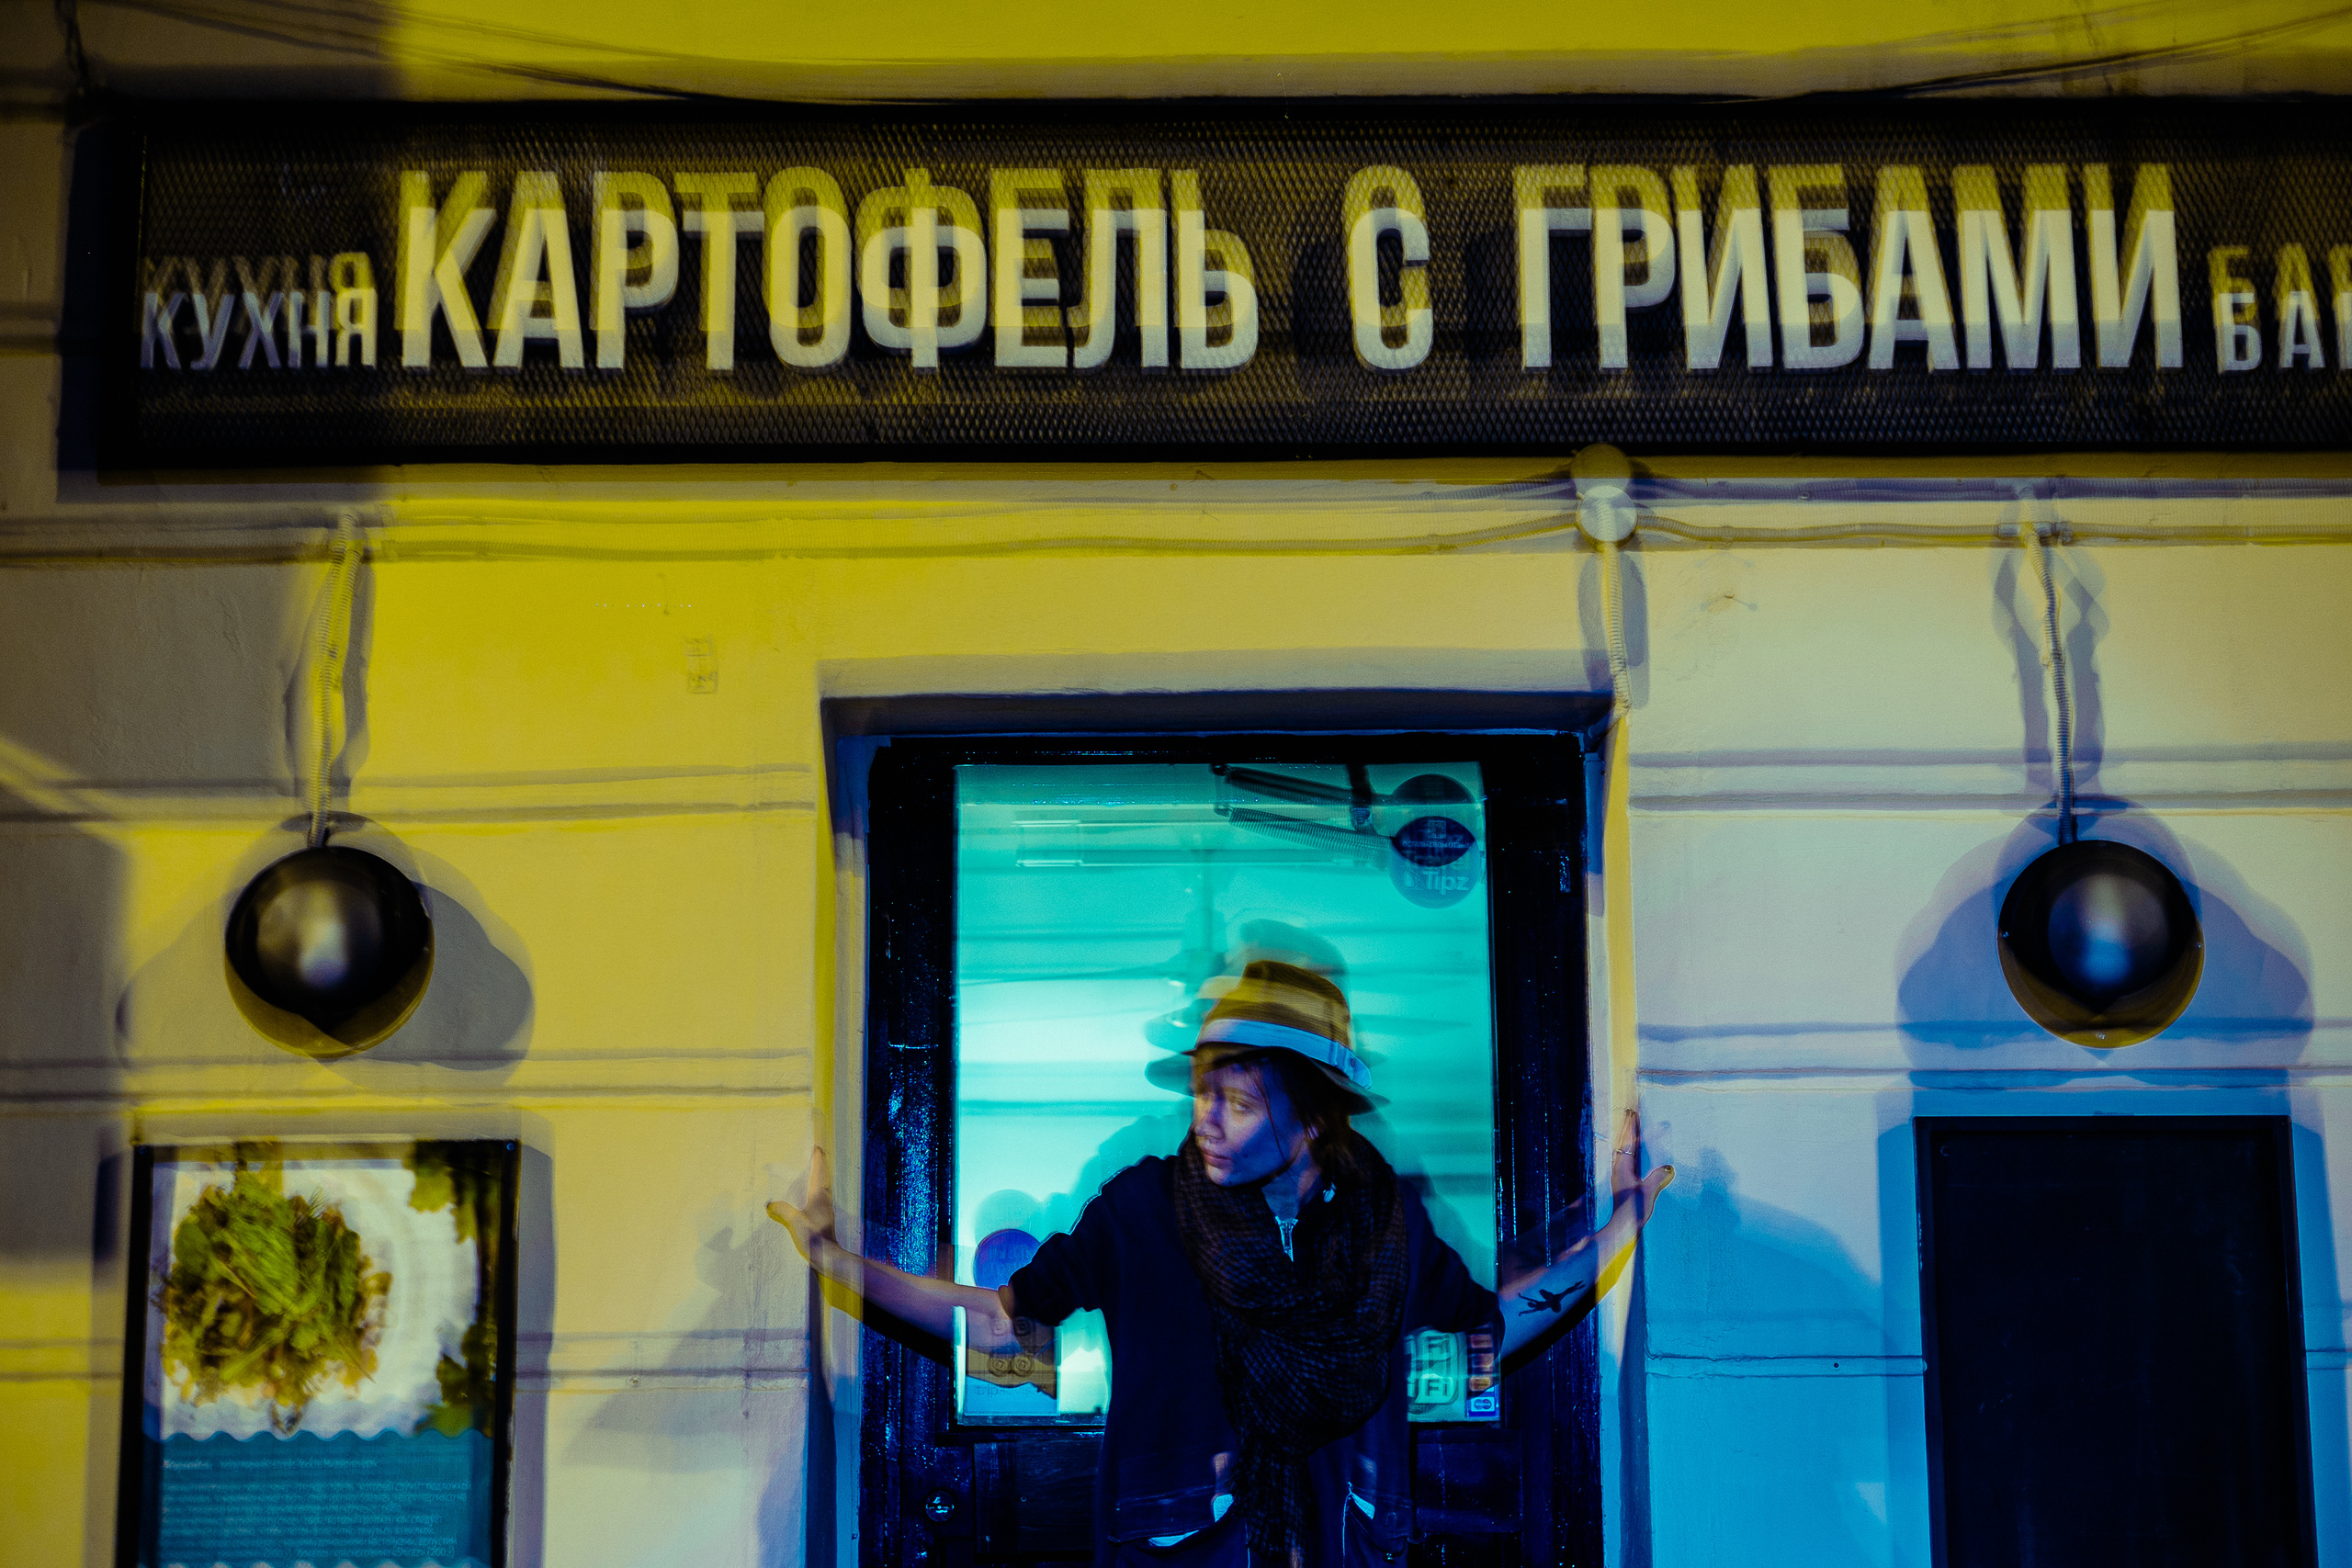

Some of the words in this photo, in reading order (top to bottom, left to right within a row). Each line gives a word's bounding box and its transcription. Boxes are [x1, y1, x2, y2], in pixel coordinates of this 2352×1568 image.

[139, 265, 378, 370] КУХНЯ
[393, 168, 1260, 371] КАРТОФЕЛЬ
[1344, 167, 1434, 371] С
[1514, 164, 2184, 371] ГРИБАМИ
[1422, 870, 1470, 896] Tipz
